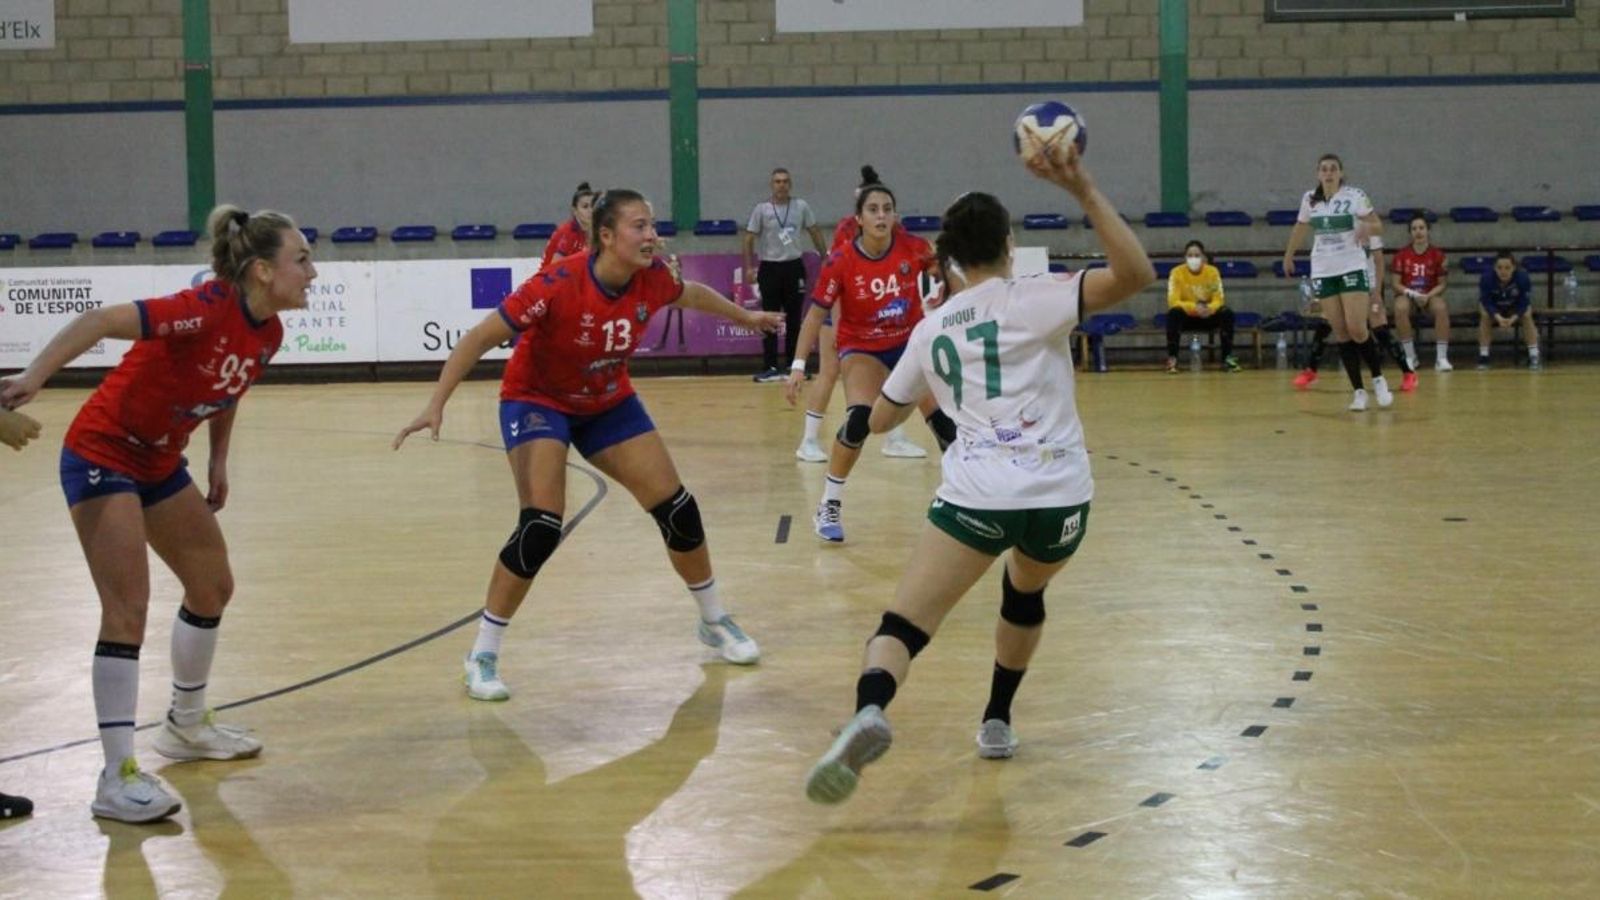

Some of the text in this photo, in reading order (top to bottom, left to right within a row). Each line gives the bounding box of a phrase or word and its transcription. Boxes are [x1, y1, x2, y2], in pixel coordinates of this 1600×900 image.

[0, 20, 41, 39] d'Elx
[1334, 200, 1351, 214] 22
[1412, 263, 1425, 276] 31
[8, 277, 92, 287] Comunitat Valenciana
[871, 274, 901, 300] 94
[8, 287, 92, 301] COMUNITAT
[15, 302, 34, 314] DE
[173, 317, 203, 330] DXT
[286, 317, 346, 328] CANTE
[602, 318, 632, 352] 13
[296, 334, 347, 352] Pueblos
[212, 354, 255, 394] 95
